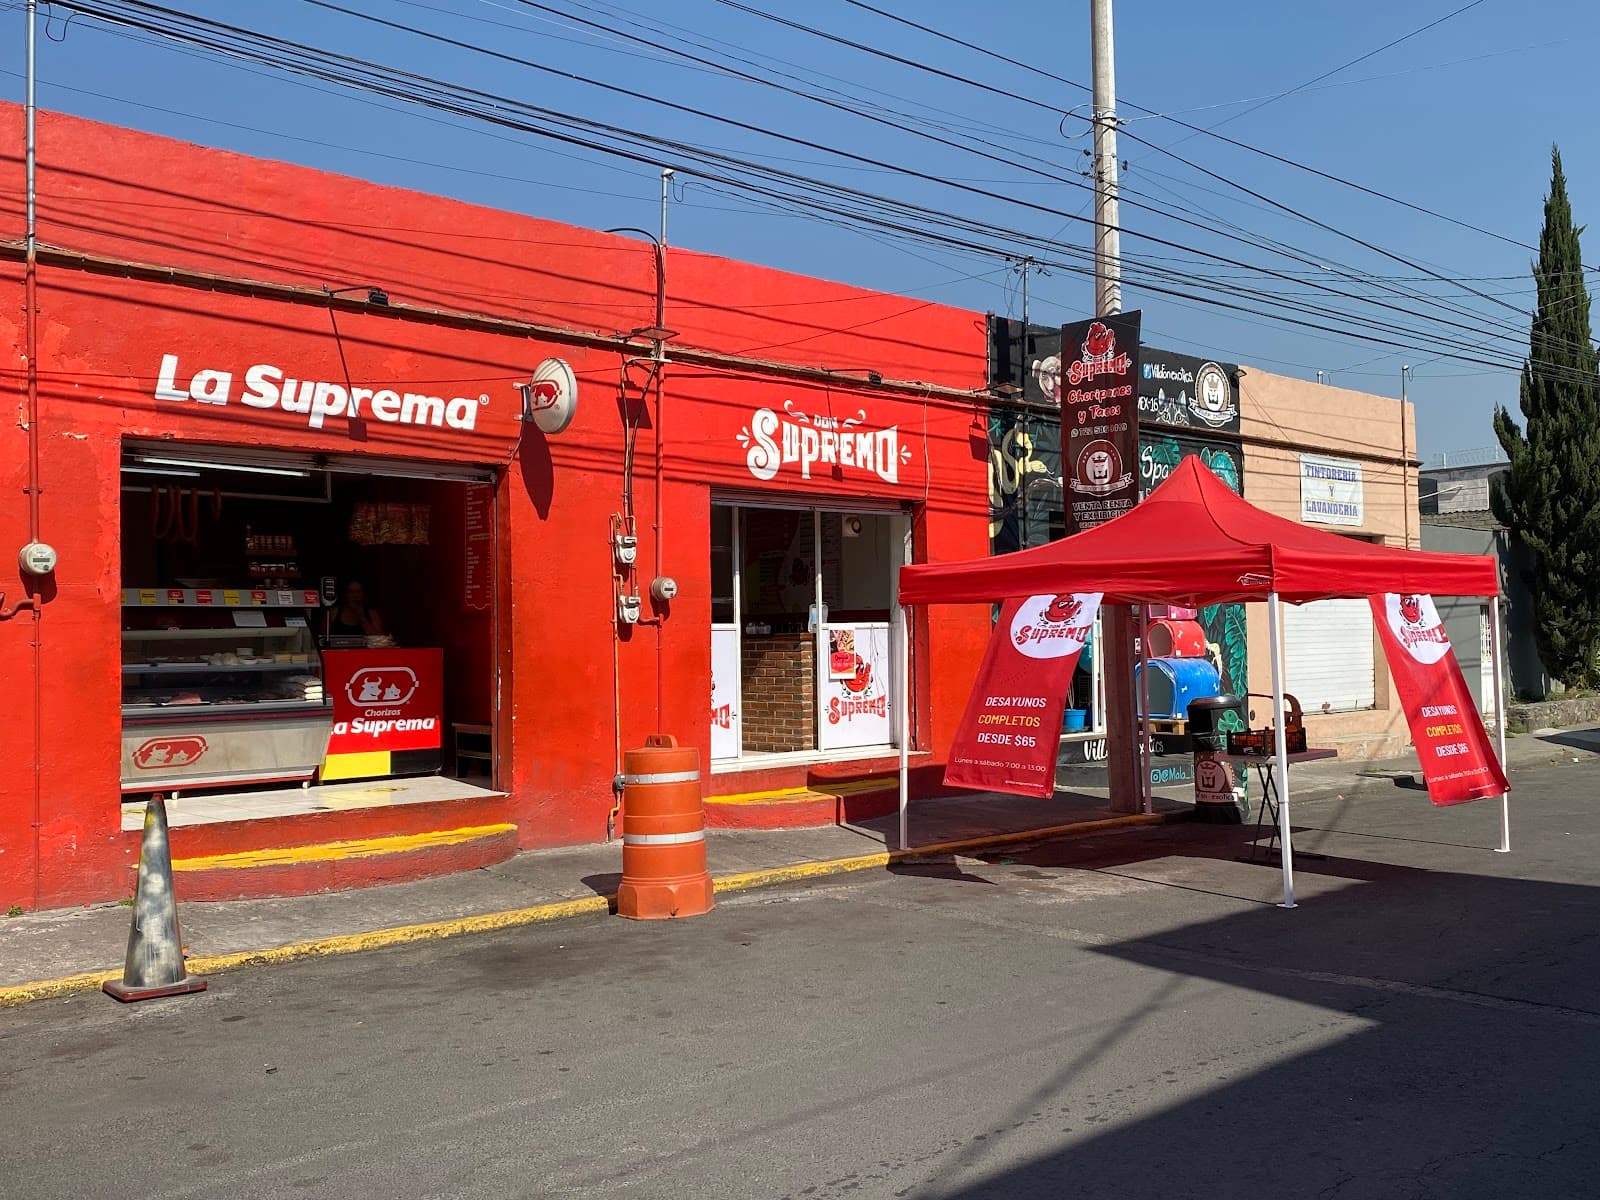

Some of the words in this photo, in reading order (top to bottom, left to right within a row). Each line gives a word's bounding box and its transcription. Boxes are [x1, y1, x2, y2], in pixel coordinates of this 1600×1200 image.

[155, 354, 232, 405] La
[240, 364, 478, 430] Suprema
[1068, 385, 1132, 404] Choripanes
[813, 414, 839, 428] DON
[1077, 410, 1087, 425] y
[1089, 404, 1121, 419] Tacos
[747, 408, 899, 484] SUPREMO
[1328, 485, 1336, 497] Y
[1072, 500, 1102, 512] VENTA
[1103, 499, 1134, 509] RENTA
[985, 696, 1047, 708] DESAYUNOS
[364, 708, 402, 717] Chorizos
[828, 694, 886, 725] SUPREMO
[1421, 704, 1457, 718] DESAYUNOS
[330, 721, 348, 735] a
[350, 717, 436, 738] Suprema
[978, 714, 1041, 728] COMPLETOS
[1426, 724, 1463, 737] COMPLETOS
[977, 732, 1012, 745] DESDE
[1014, 734, 1036, 748] $65
[1435, 744, 1460, 757] DESDE
